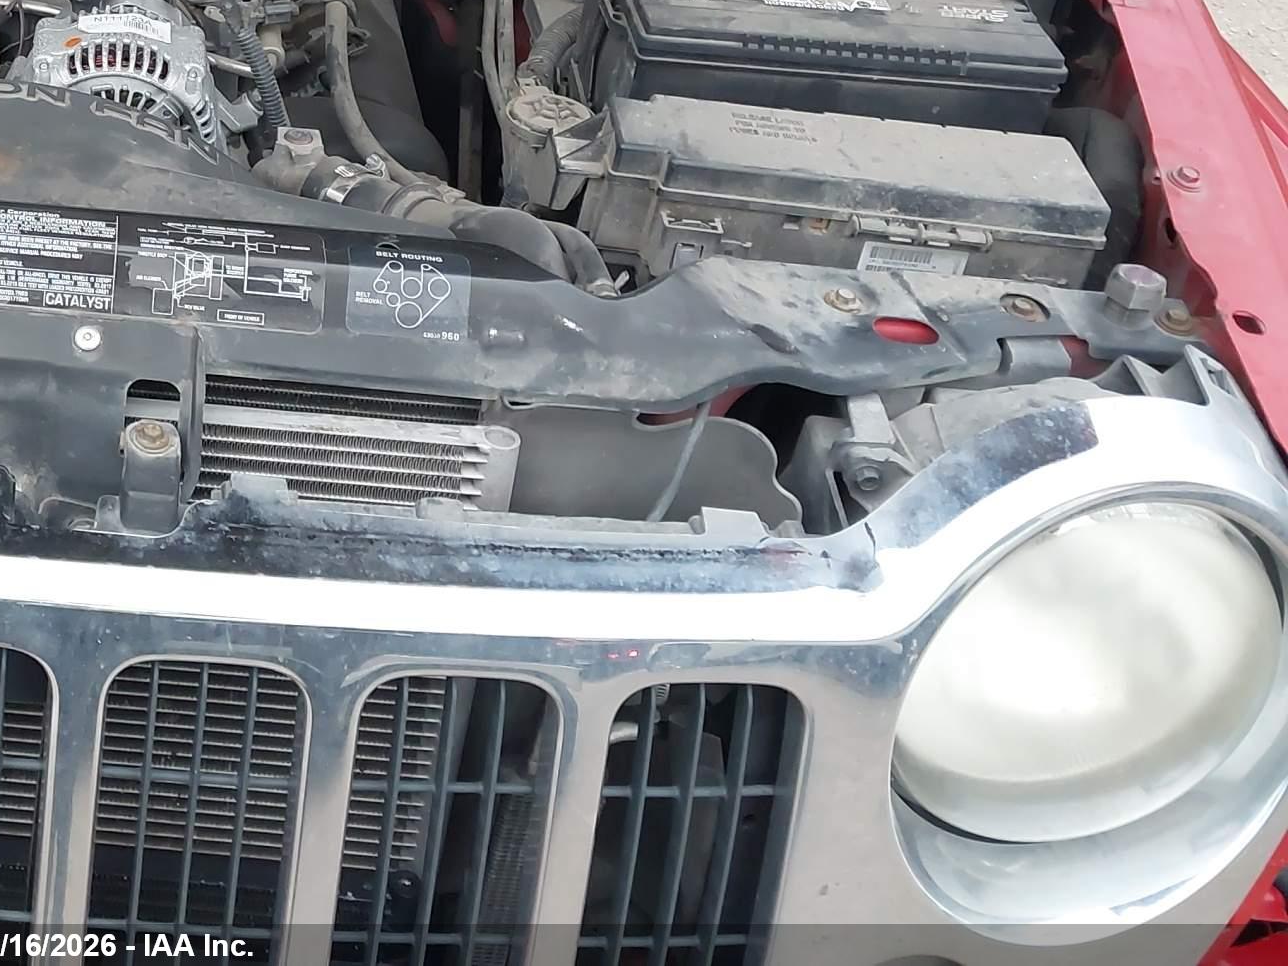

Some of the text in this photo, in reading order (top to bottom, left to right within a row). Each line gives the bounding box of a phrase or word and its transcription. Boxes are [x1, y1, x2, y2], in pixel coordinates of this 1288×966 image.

[40, 216, 106, 227] INFORMATION
[376, 251, 443, 262] BELT ROUTING
[45, 292, 111, 310] CATALYST
[355, 296, 384, 305] REMOVAL
